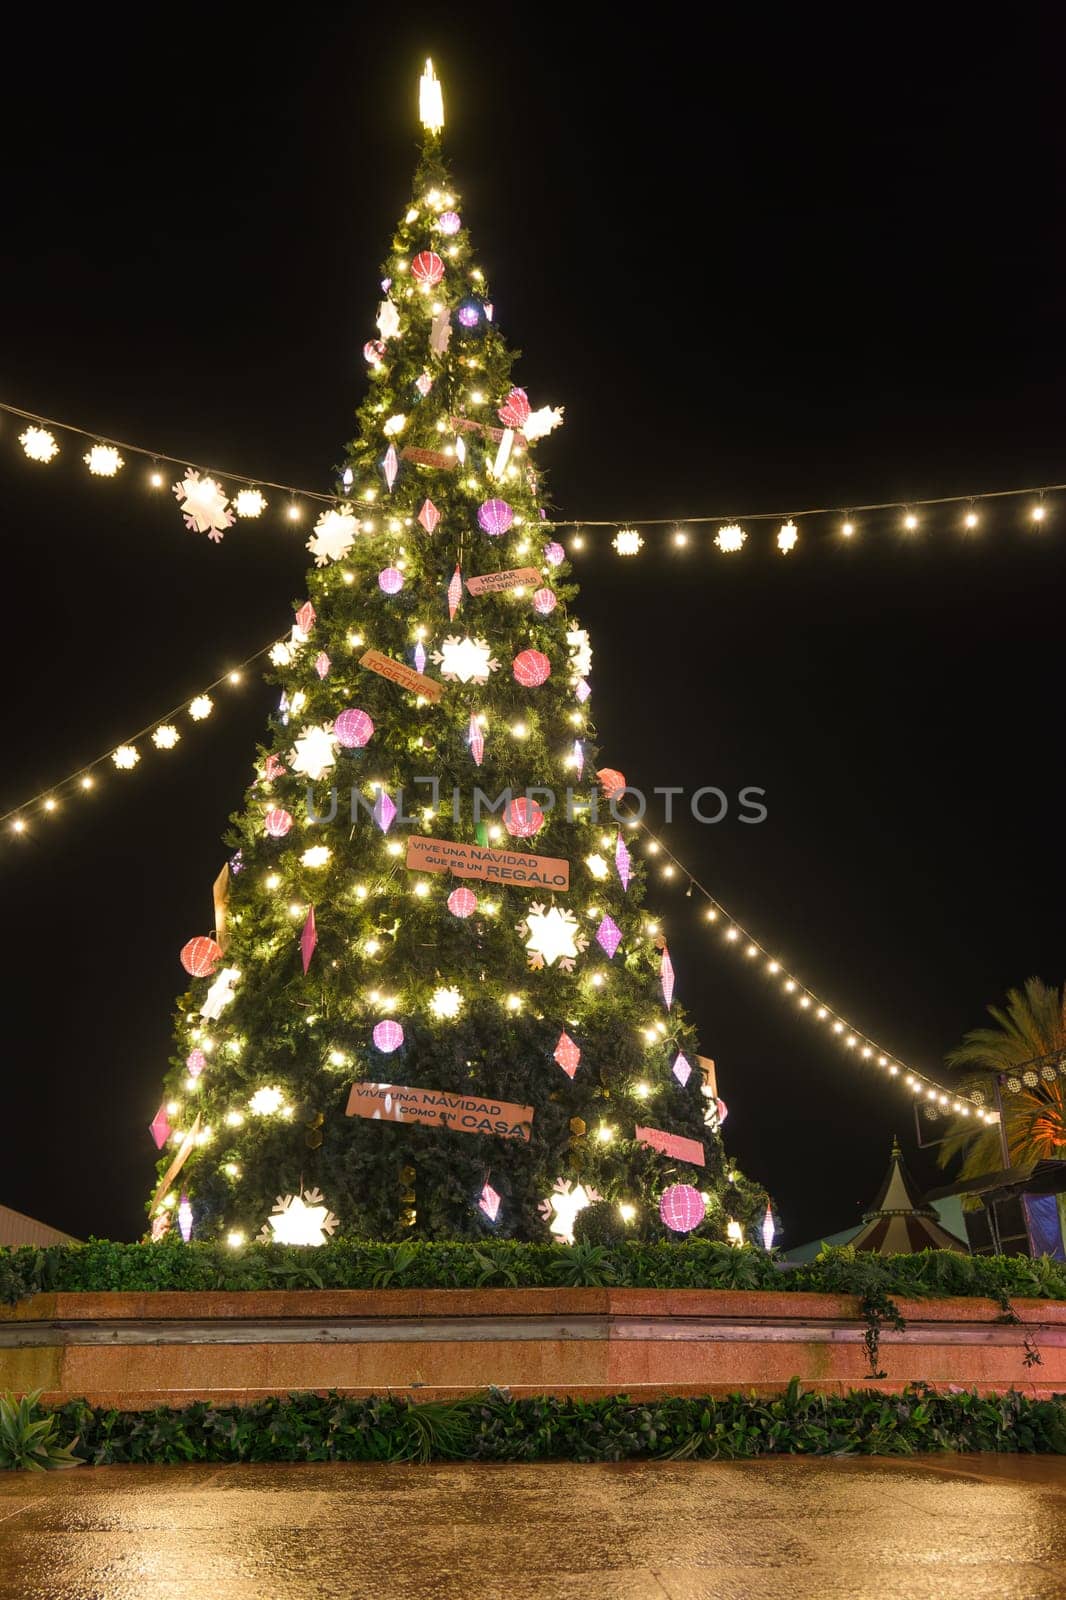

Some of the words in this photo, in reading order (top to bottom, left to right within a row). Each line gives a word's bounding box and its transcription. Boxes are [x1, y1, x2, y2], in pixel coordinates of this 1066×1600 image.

[497, 577, 537, 590] NAVIDAD
[367, 658, 433, 698] TOGETHER
[412, 842, 440, 853] VIVE
[443, 847, 467, 857] UNA
[471, 850, 538, 868] NAVIDAD
[425, 857, 447, 866] QUE
[451, 861, 465, 869] ES
[467, 864, 482, 872] UN
[487, 866, 567, 886] REGALO
[356, 1089, 386, 1099] VIVE
[391, 1092, 417, 1103] UNA
[423, 1095, 502, 1116] NAVIDAD
[400, 1106, 436, 1118] COMO
[439, 1112, 457, 1121] EN
[461, 1116, 526, 1138] CASA
